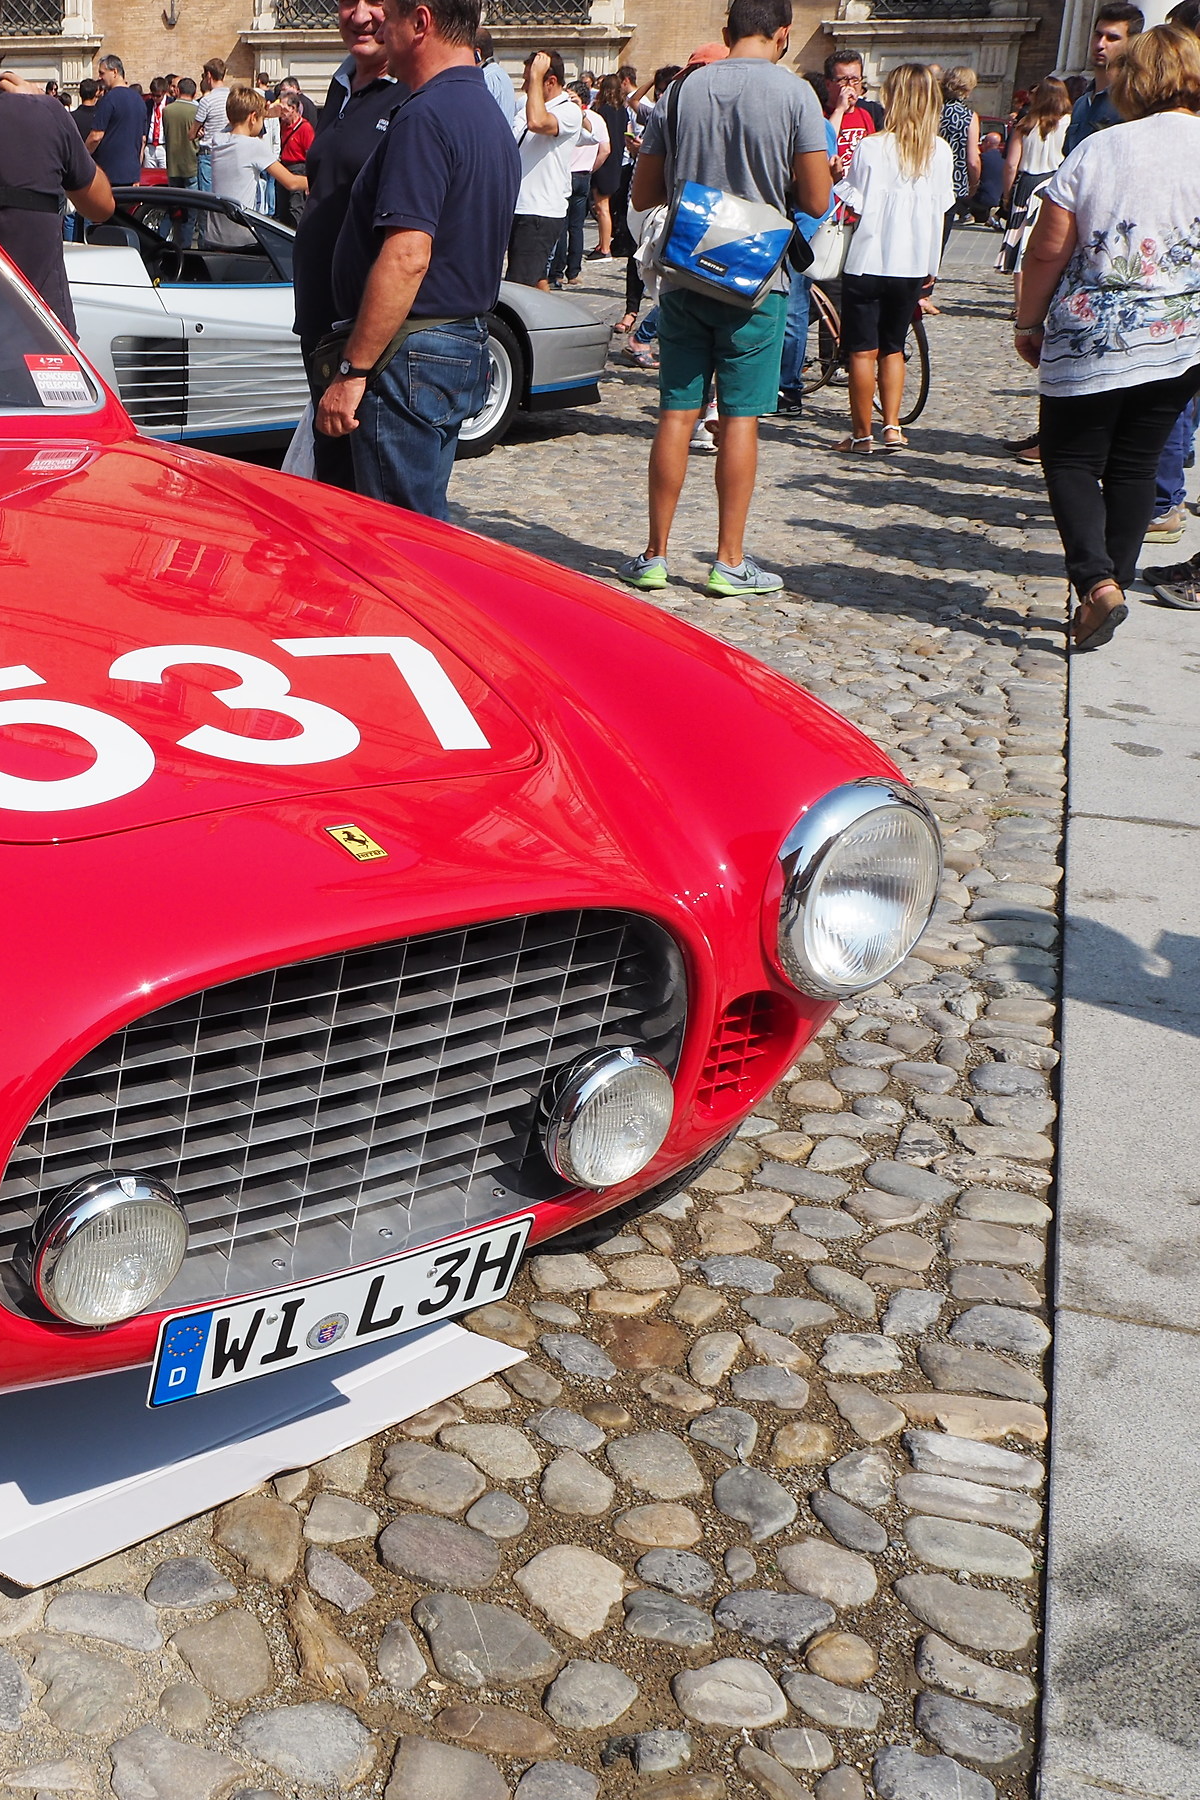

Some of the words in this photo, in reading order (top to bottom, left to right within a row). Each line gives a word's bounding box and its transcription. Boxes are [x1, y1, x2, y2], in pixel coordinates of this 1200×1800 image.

[37, 372, 79, 381] CONCORSO
[211, 1297, 305, 1380] WI
[356, 1275, 404, 1337] L
[417, 1231, 522, 1316] 3H
[168, 1366, 187, 1388] D
